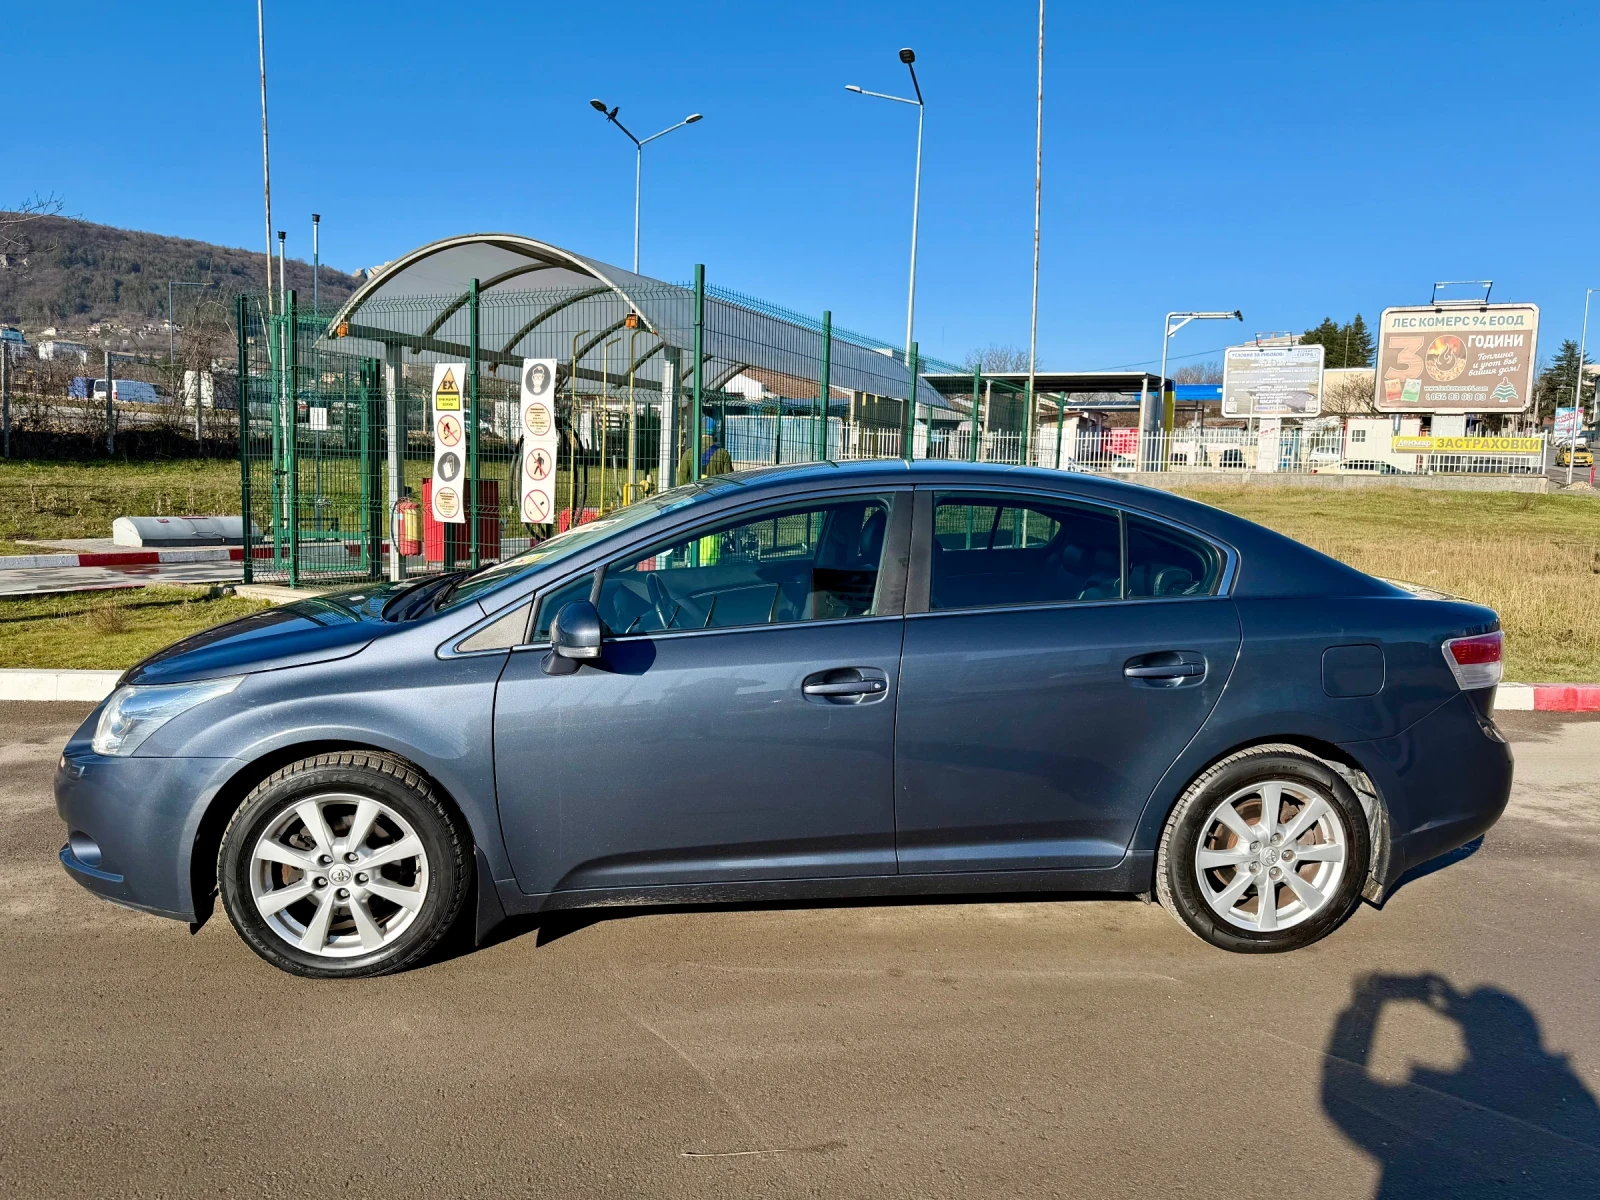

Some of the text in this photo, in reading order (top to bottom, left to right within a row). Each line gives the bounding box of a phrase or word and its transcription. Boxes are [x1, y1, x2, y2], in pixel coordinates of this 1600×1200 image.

[1392, 314, 1524, 328] ЛЕС КОМЕРС 94 ЕООД
[1467, 334, 1524, 349] ГОДИНИ
[1477, 351, 1514, 361] Топлина
[1480, 360, 1501, 370] уют
[1503, 357, 1518, 366] във
[1468, 364, 1521, 377] вашия дом!
[442, 380, 454, 390] EX
[1437, 438, 1539, 450] ЗАСТРАХОВКИ
